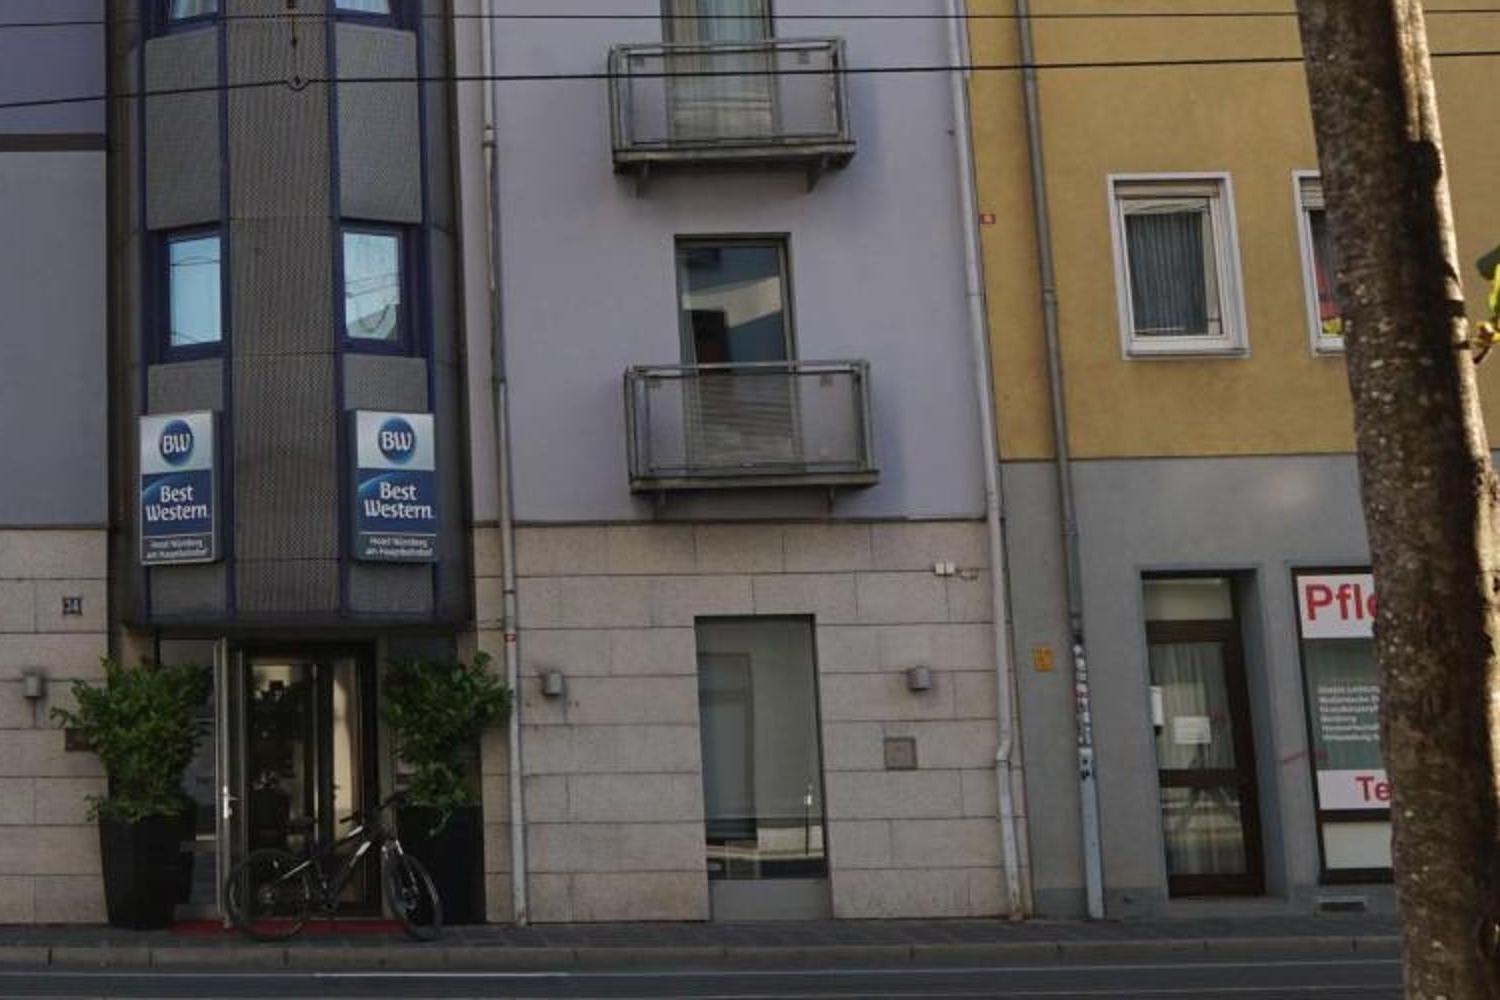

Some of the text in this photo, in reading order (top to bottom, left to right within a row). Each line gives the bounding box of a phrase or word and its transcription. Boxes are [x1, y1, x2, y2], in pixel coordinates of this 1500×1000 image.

[163, 433, 190, 454] BW
[382, 431, 412, 451] BW
[161, 485, 194, 503] Best
[380, 481, 417, 500] Best
[146, 503, 208, 522] Western
[364, 500, 434, 519] Western
